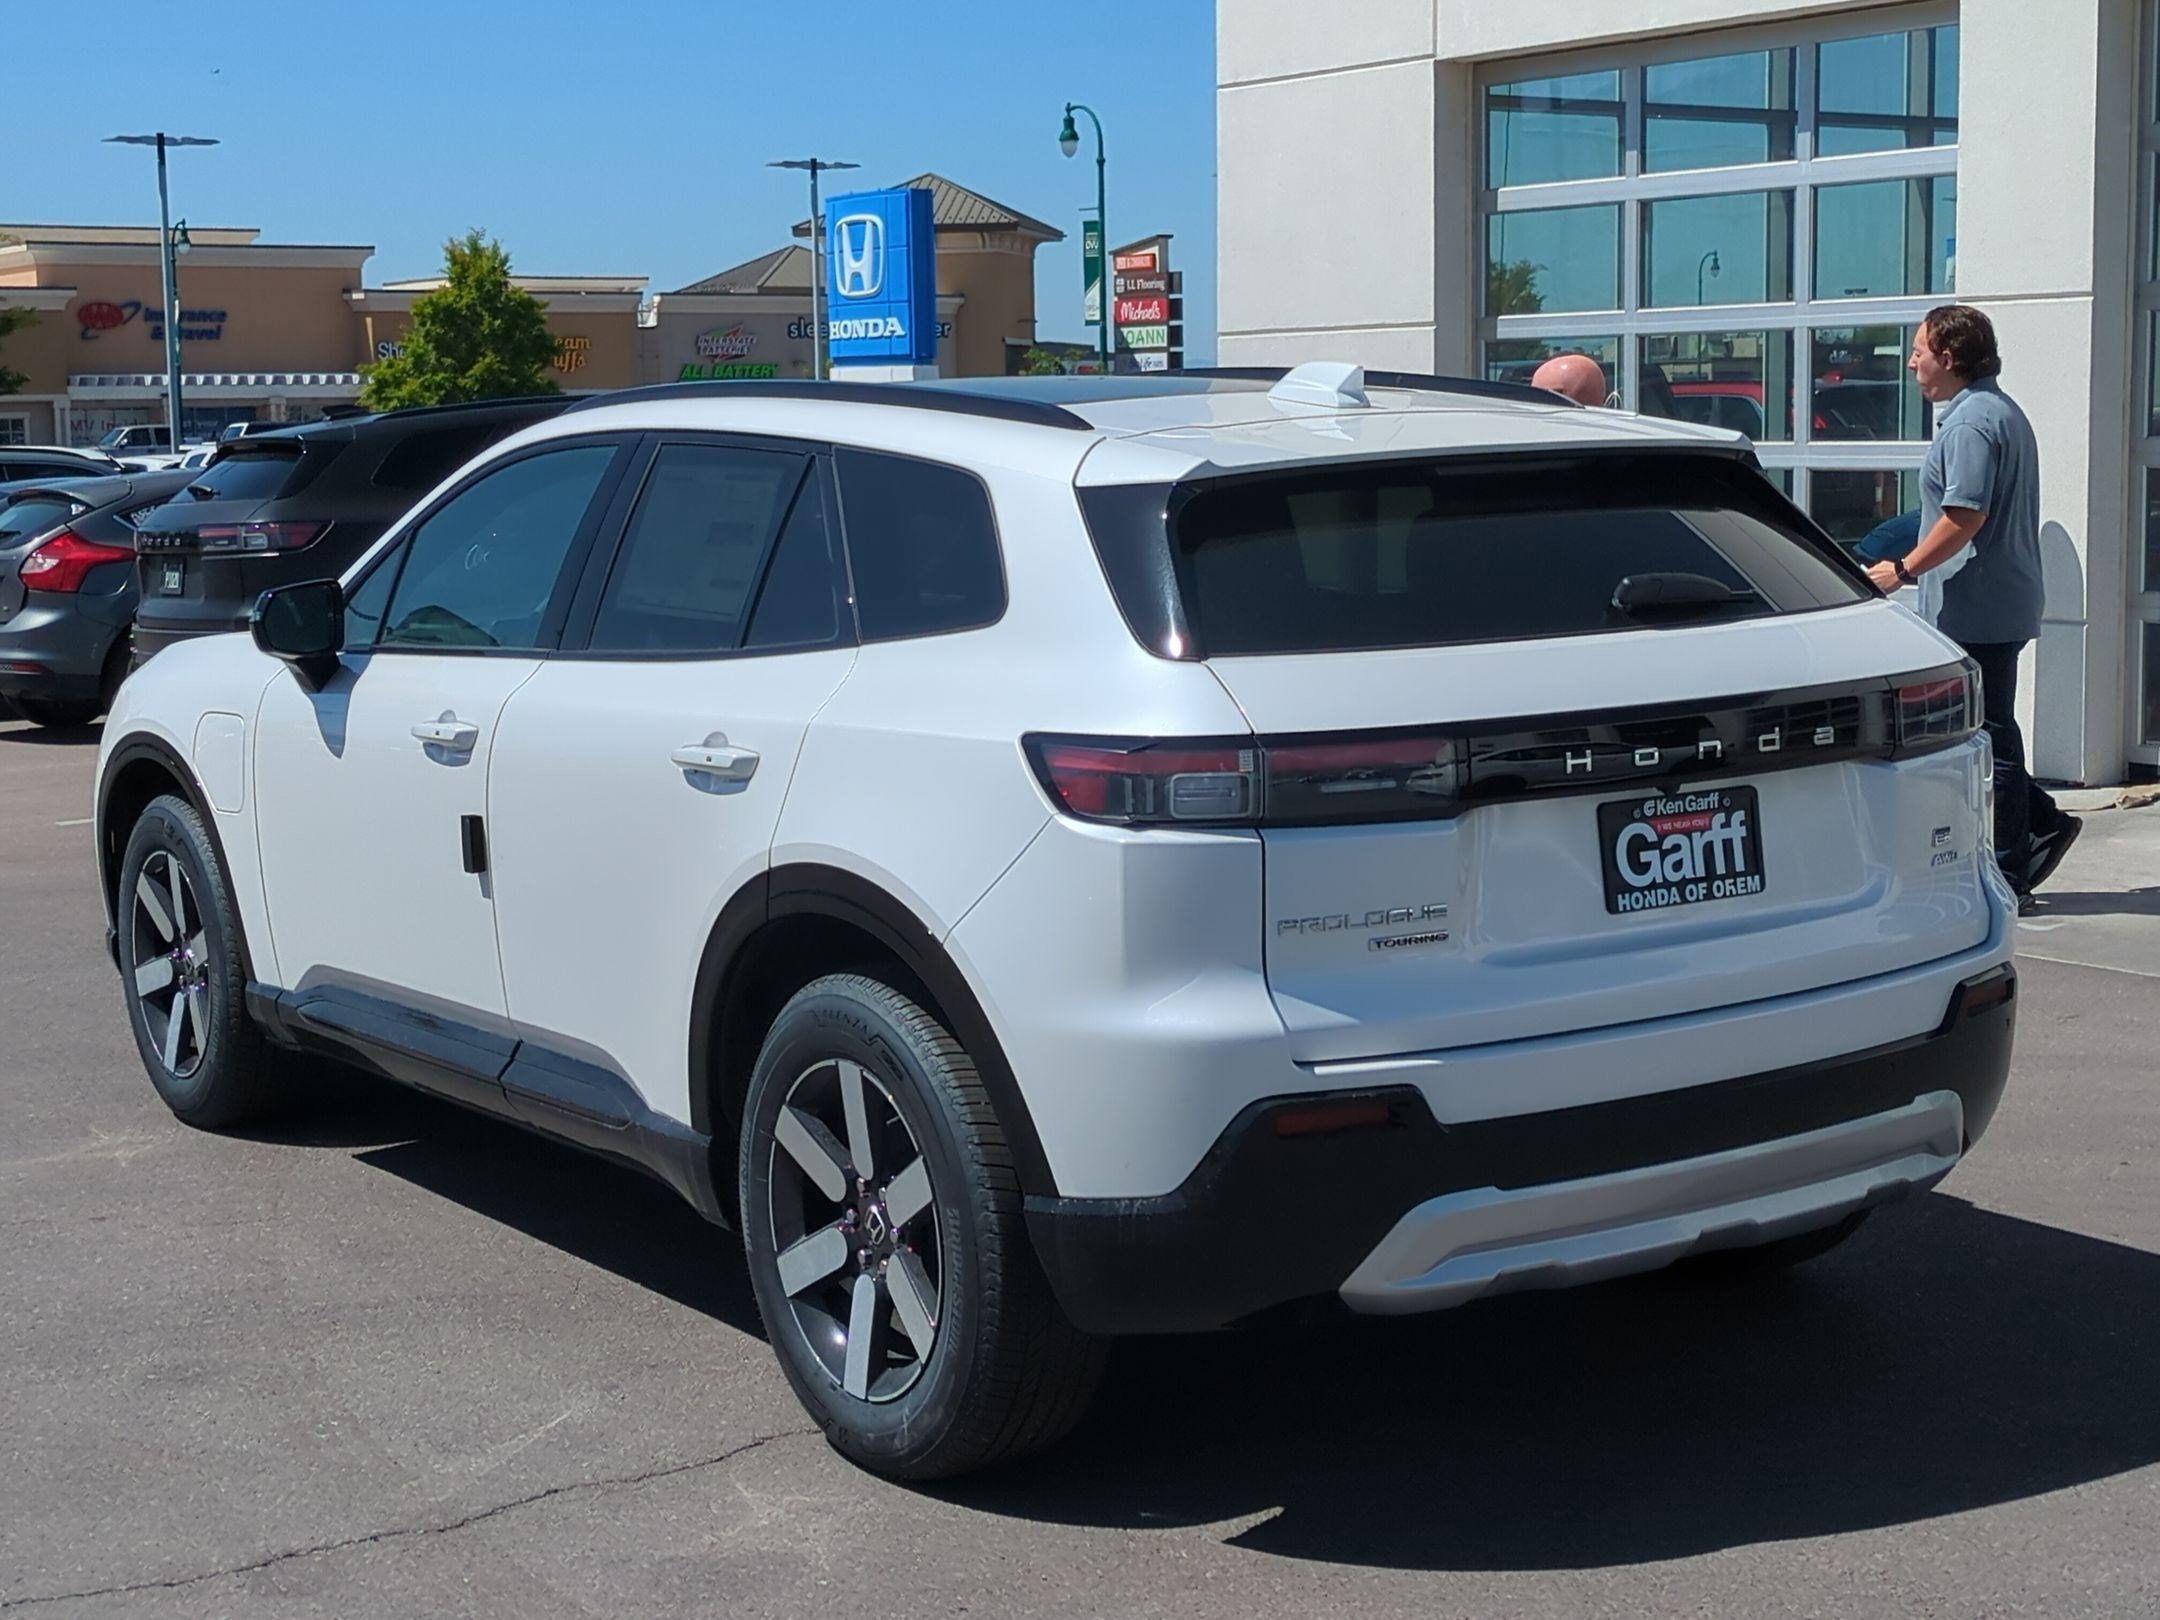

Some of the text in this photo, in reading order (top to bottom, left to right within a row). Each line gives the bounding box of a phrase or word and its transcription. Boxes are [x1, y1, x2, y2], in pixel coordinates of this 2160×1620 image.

[1137, 279, 1165, 291] Flooring
[144, 308, 227, 322] Inrance
[1120, 301, 1161, 321] Michaels
[789, 318, 829, 337] slee
[829, 317, 905, 340] HONDA
[1117, 328, 1165, 346] JOANN
[553, 351, 587, 373] uffs
[680, 363, 780, 379] ALL BATTERY
[1656, 798, 1683, 816] Ken
[1685, 792, 1719, 812] Garff
[1616, 810, 1747, 887] Garff
[1616, 875, 1761, 912] HONDA OF OREM
[1277, 903, 1449, 936] PROLOGUE
[1374, 932, 1449, 950] TOURING
